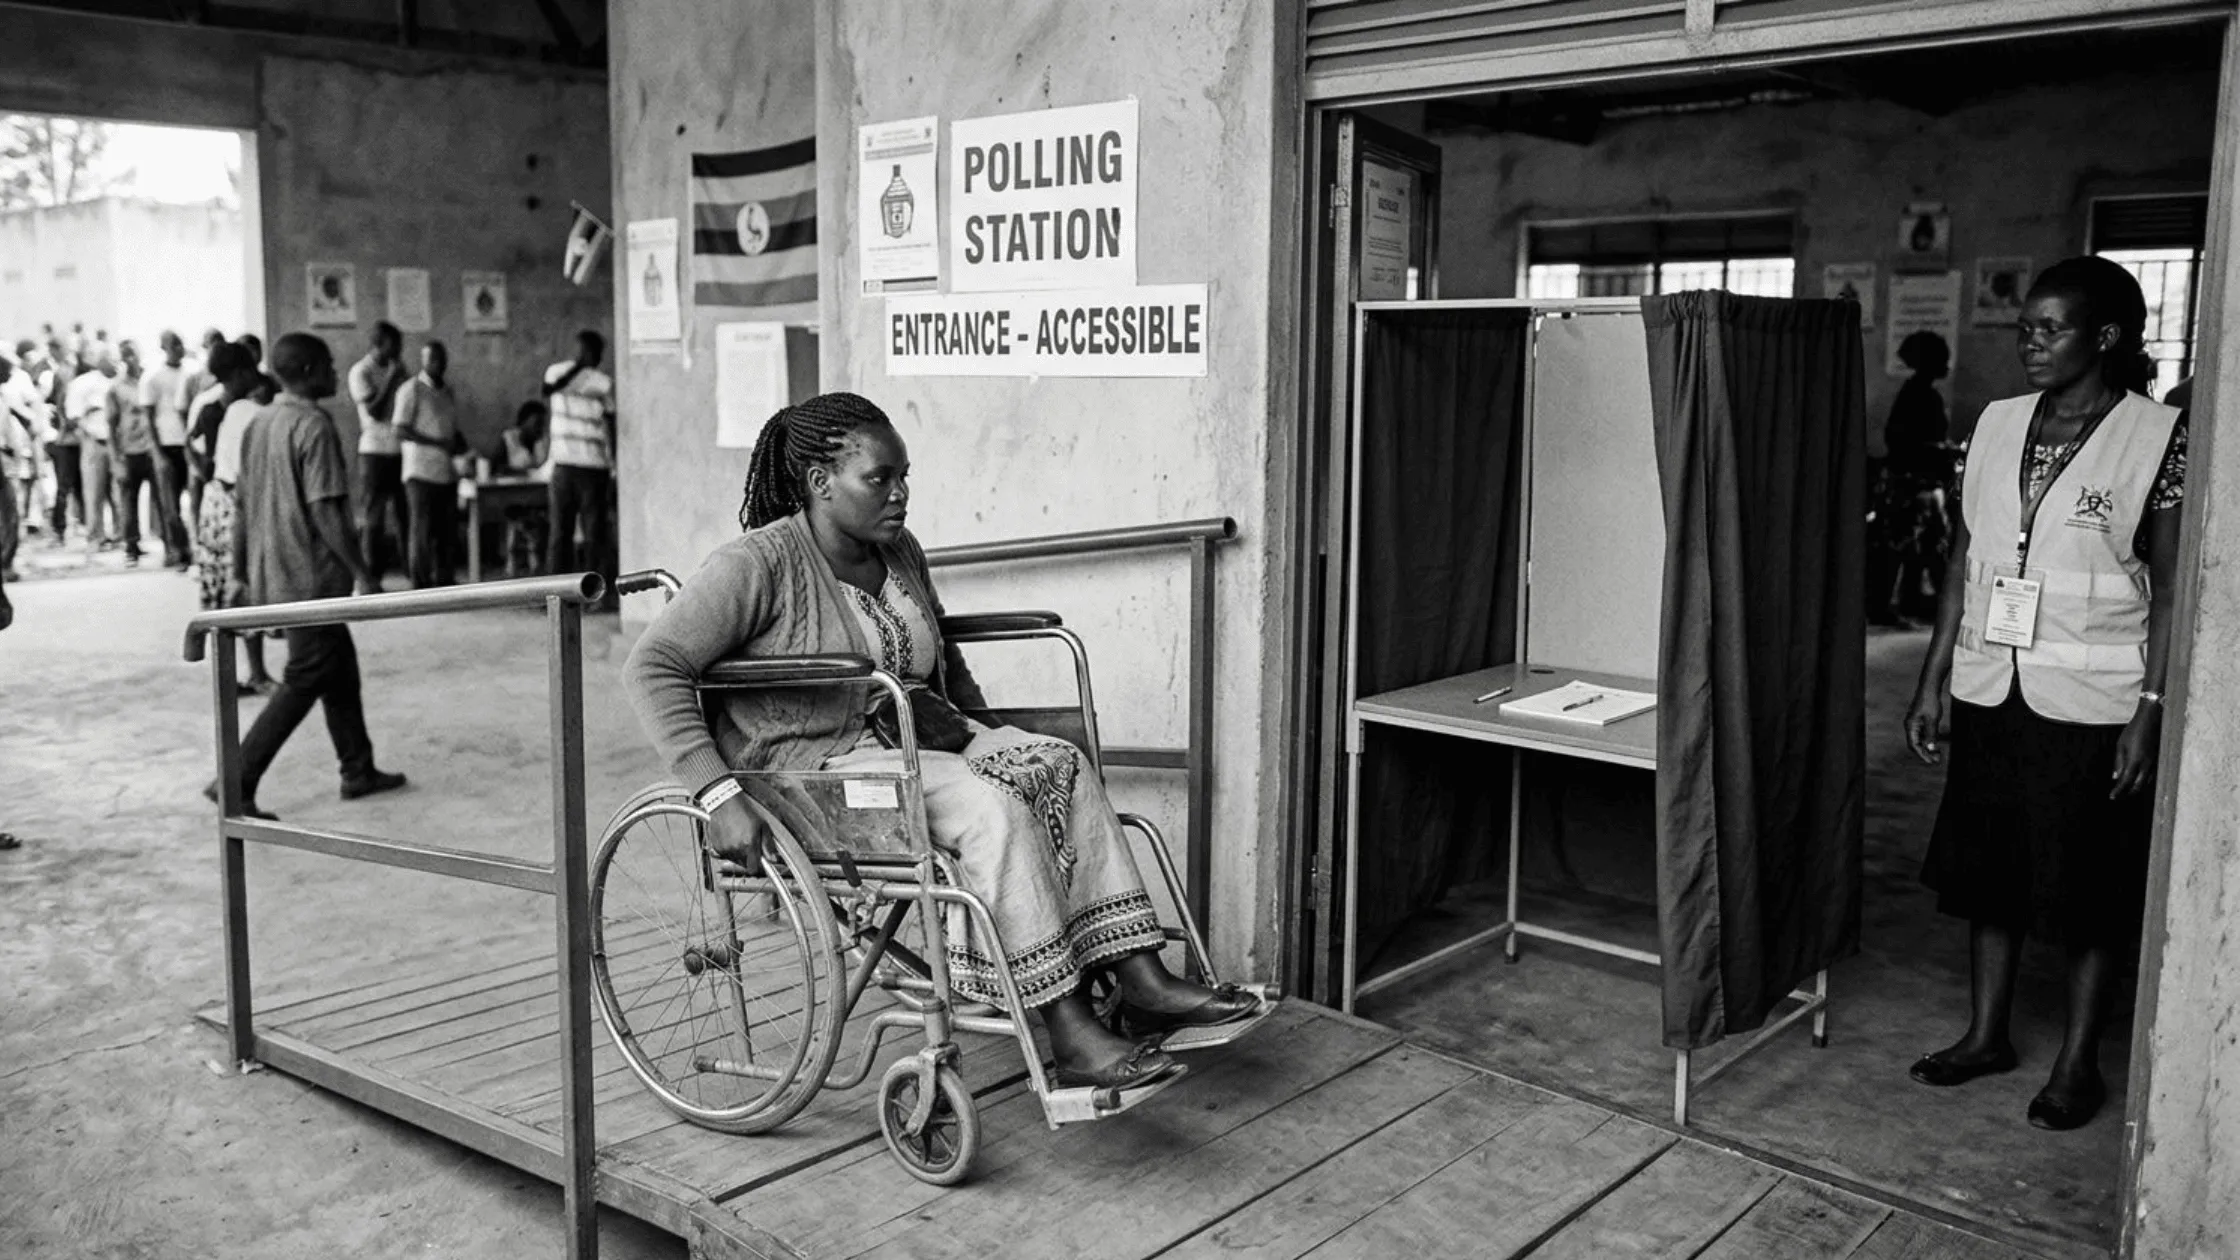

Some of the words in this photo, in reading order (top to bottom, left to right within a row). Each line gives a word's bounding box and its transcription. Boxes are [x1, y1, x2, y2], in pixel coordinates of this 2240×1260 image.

[964, 130, 1122, 194] POLLING
[964, 207, 1121, 264] STATION
[891, 310, 1011, 356] ENTRANCE
[1017, 333, 1029, 342] -
[1036, 304, 1201, 355] ACCESSIBLE
